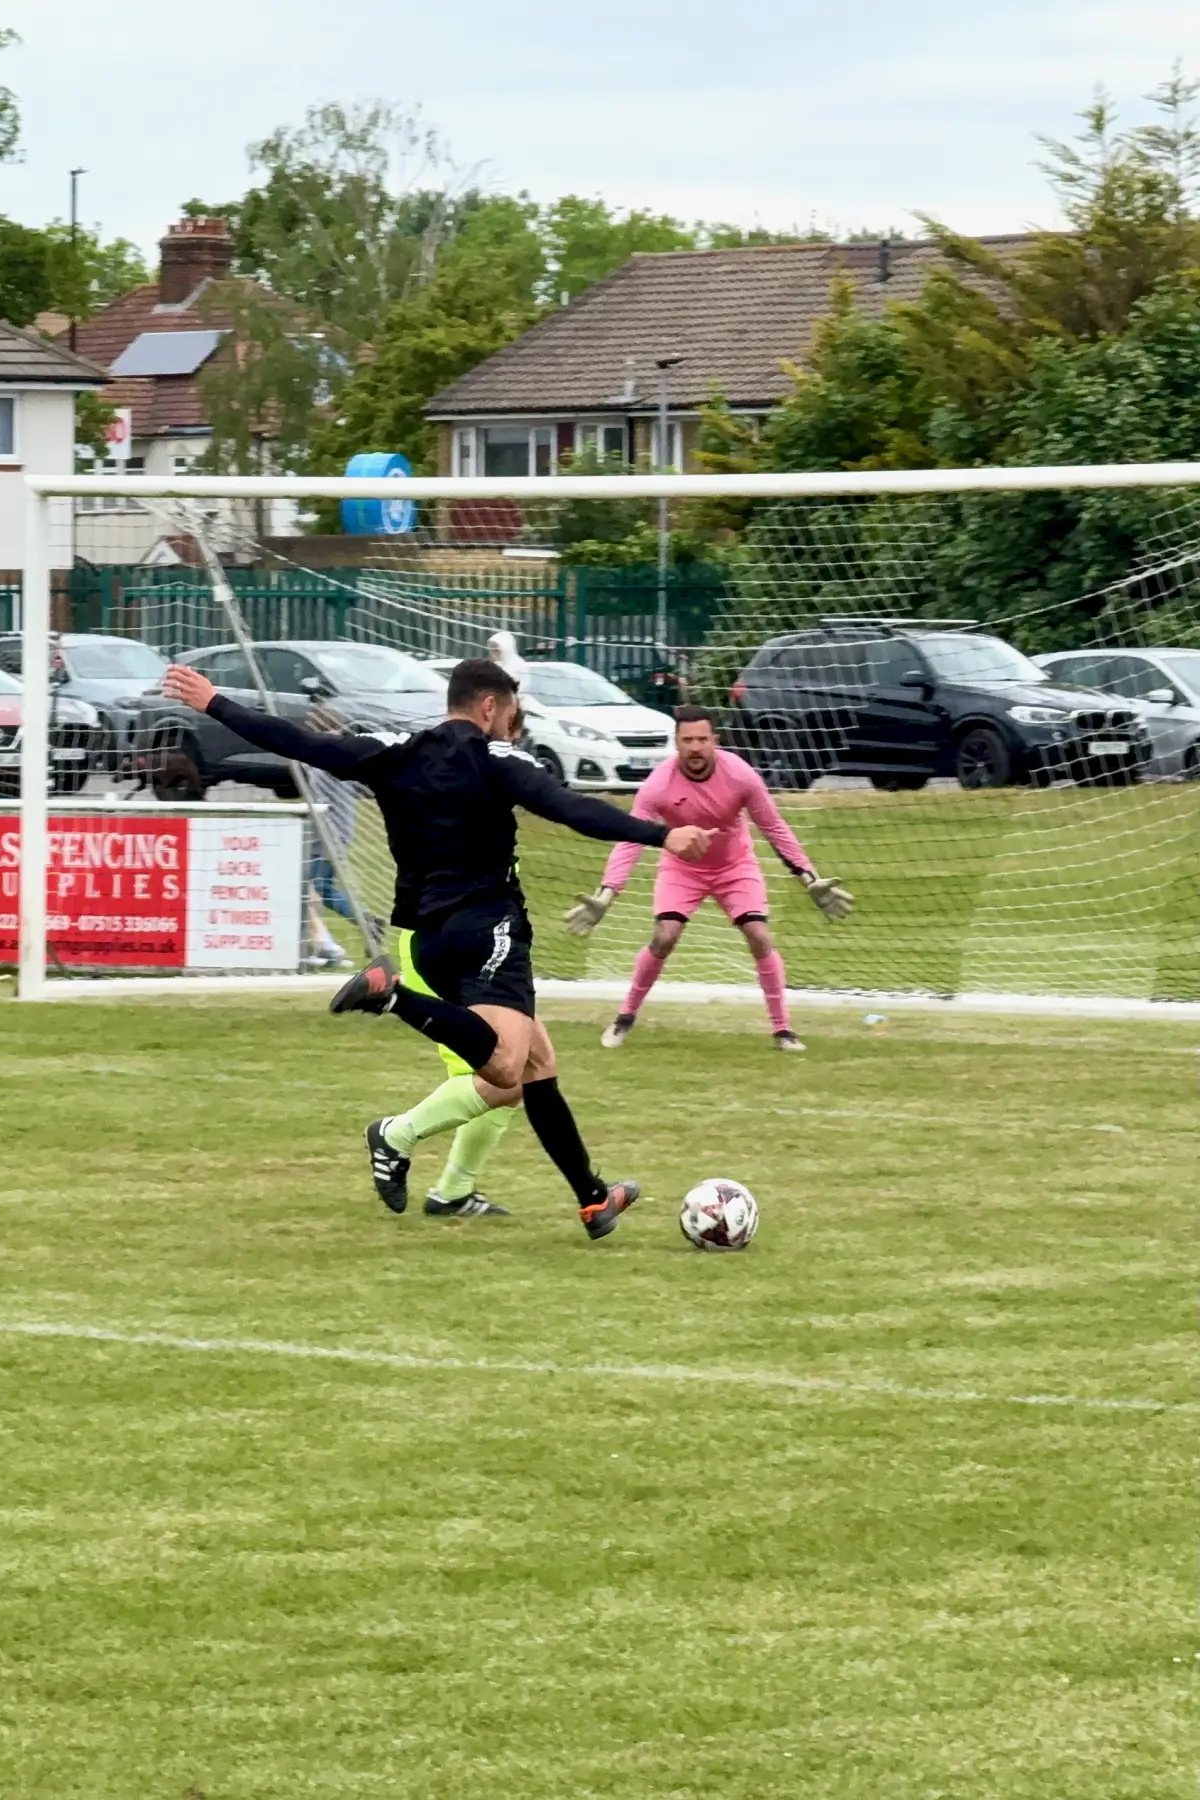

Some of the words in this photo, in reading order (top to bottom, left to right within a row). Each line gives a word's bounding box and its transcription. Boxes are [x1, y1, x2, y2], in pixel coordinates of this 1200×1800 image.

[44, 831, 180, 870] FENCING
[221, 836, 261, 851] YOUR
[217, 861, 263, 876] LOCAL
[211, 885, 269, 900] FENCING
[220, 910, 272, 925] TIMBER
[203, 934, 274, 950] SUPPLIERS
